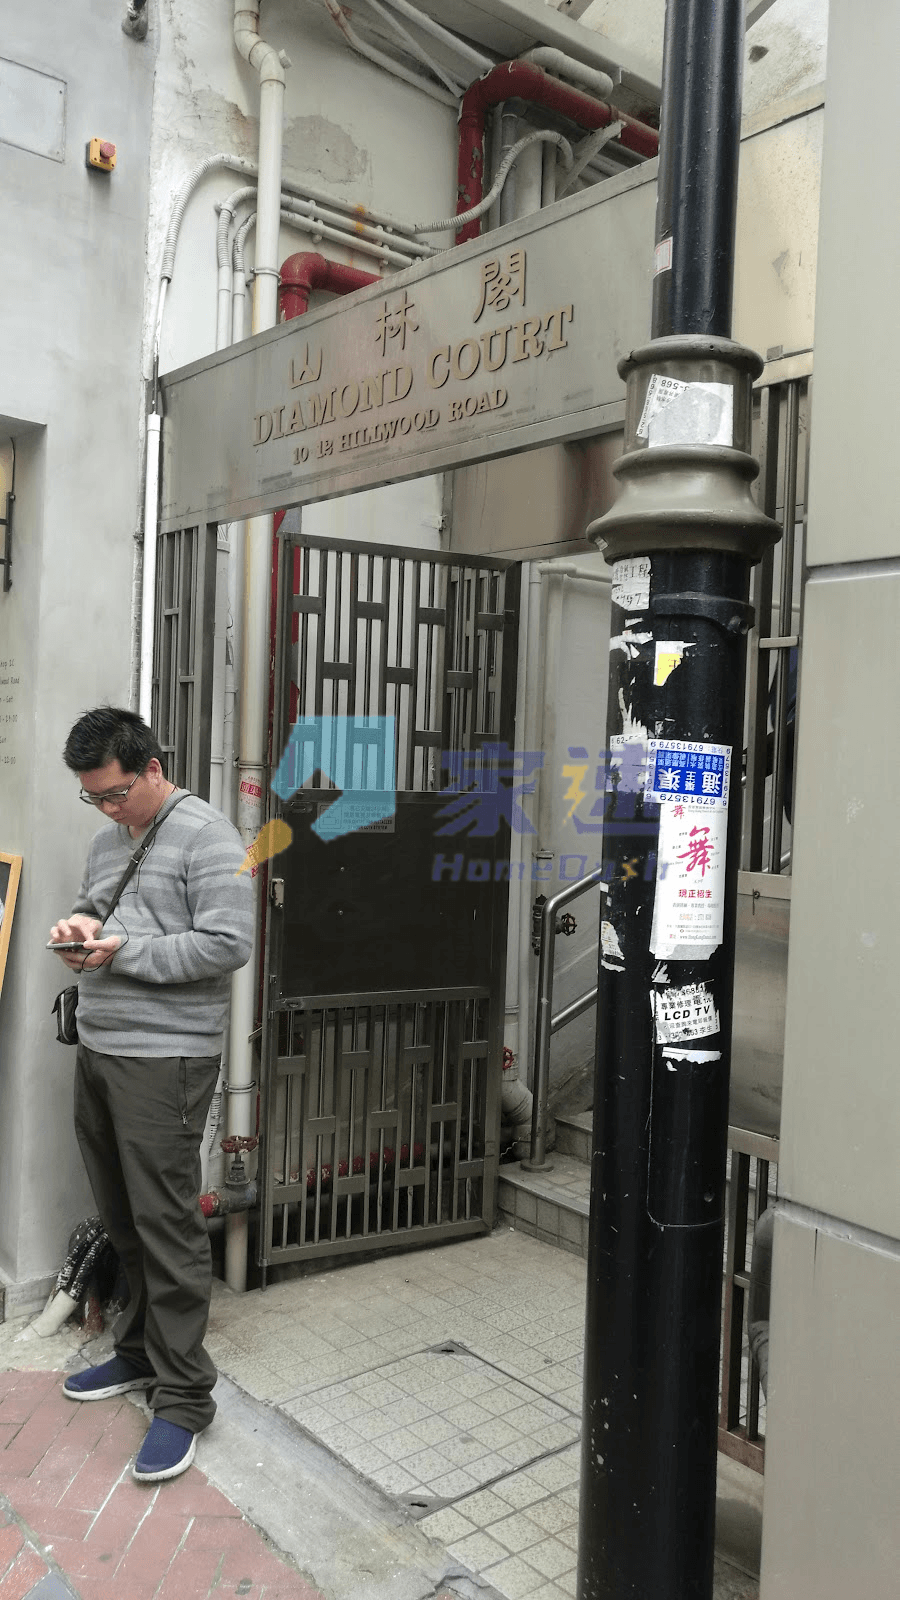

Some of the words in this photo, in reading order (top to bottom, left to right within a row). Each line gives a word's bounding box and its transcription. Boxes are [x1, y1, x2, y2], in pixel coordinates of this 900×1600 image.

[252, 366, 414, 446] DIAMOND
[427, 304, 574, 389] COURT
[338, 406, 441, 453] HILLWOOD
[448, 386, 509, 423] ROAD
[660, 741, 703, 752] 67913579
[660, 794, 716, 805] 67913579
[676, 825, 714, 878] 舞
[678, 889, 713, 899] 現正招生
[664, 1009, 691, 1021] LCD
[695, 1005, 711, 1017] TV
